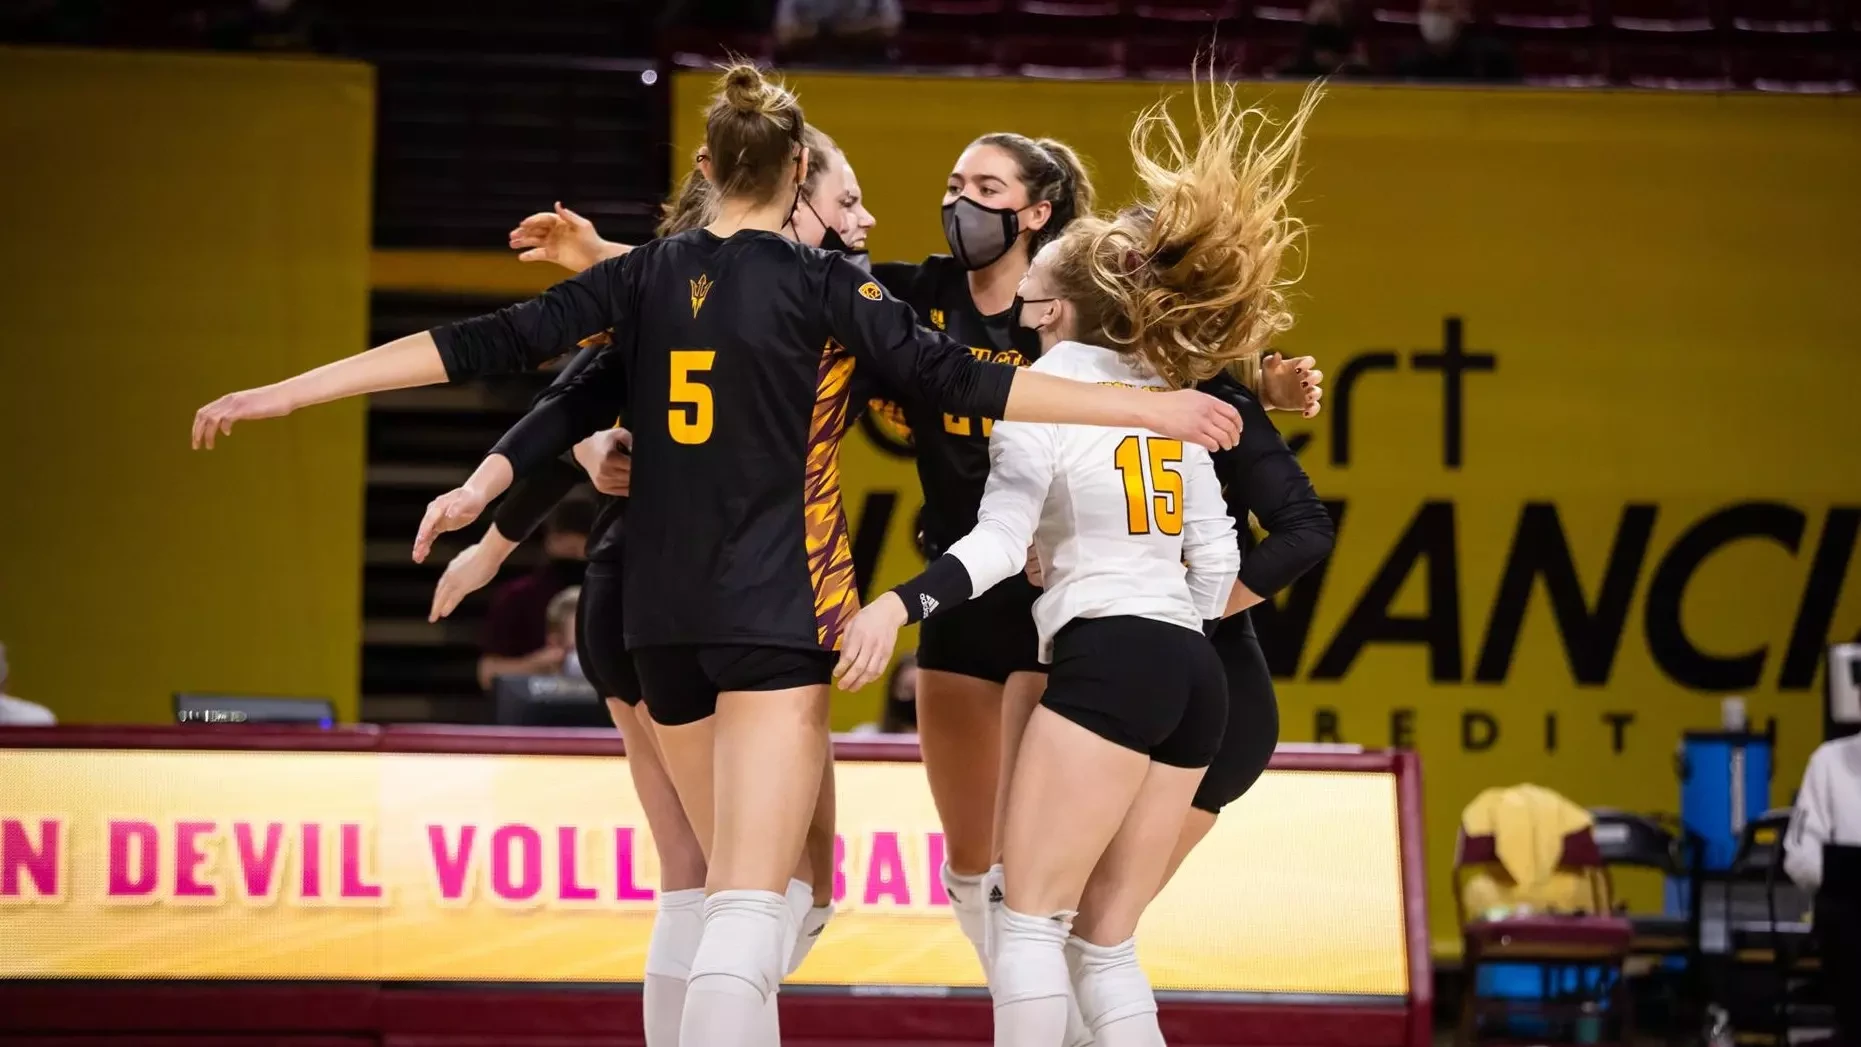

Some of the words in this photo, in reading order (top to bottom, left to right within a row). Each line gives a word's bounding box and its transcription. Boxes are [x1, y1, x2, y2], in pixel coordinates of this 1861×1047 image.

[668, 350, 716, 445] 5
[1114, 435, 1184, 536] 15
[108, 821, 381, 896] DEVIL
